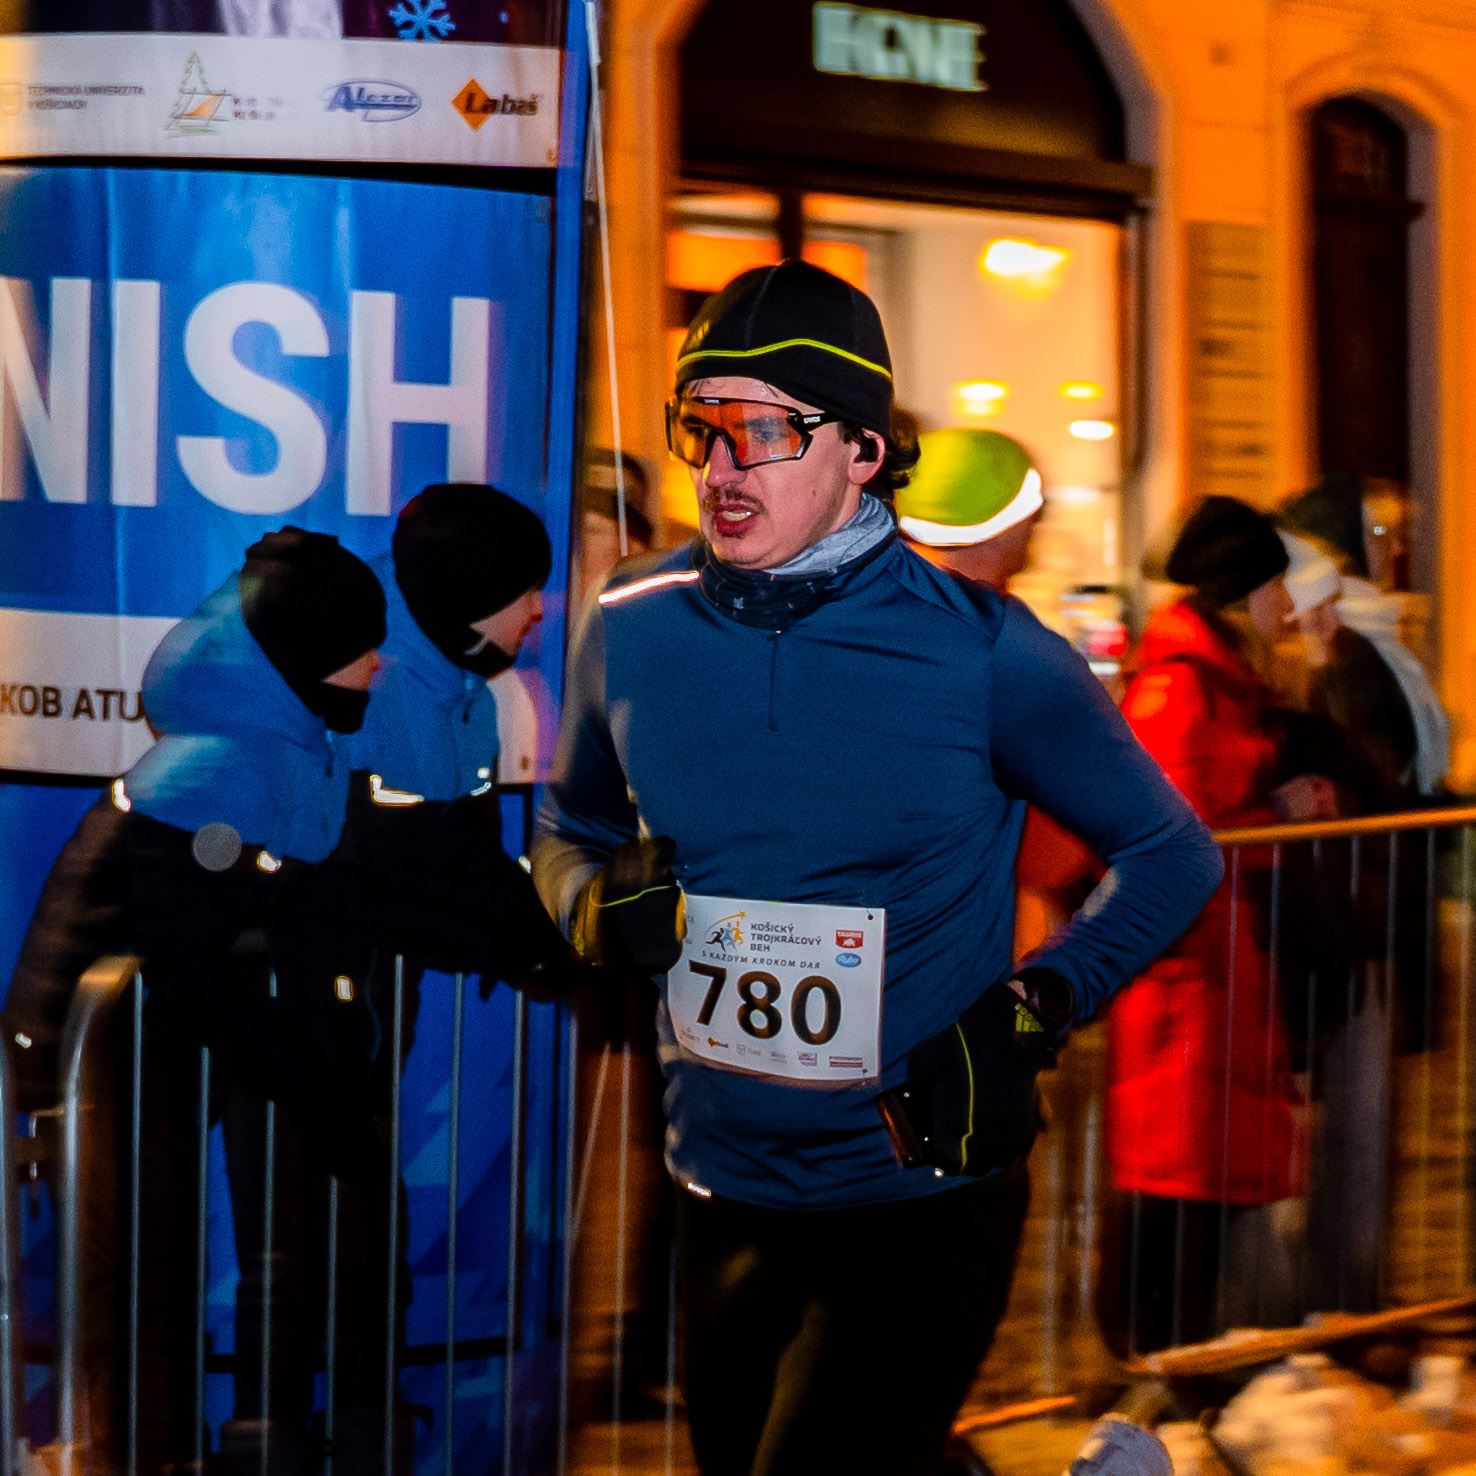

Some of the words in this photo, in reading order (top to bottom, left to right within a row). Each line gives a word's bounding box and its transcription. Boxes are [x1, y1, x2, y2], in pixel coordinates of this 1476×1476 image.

[72, 687, 145, 722] ATU
[750, 922, 794, 933] KOŠICKÝ
[751, 933, 822, 946] TROJKRÁĽOVÝ
[750, 944, 770, 952] BEH
[710, 951, 748, 963] KAŽDÝM
[752, 958, 796, 967] KROKOM
[800, 961, 821, 969] DAR
[688, 960, 841, 1046] 780
